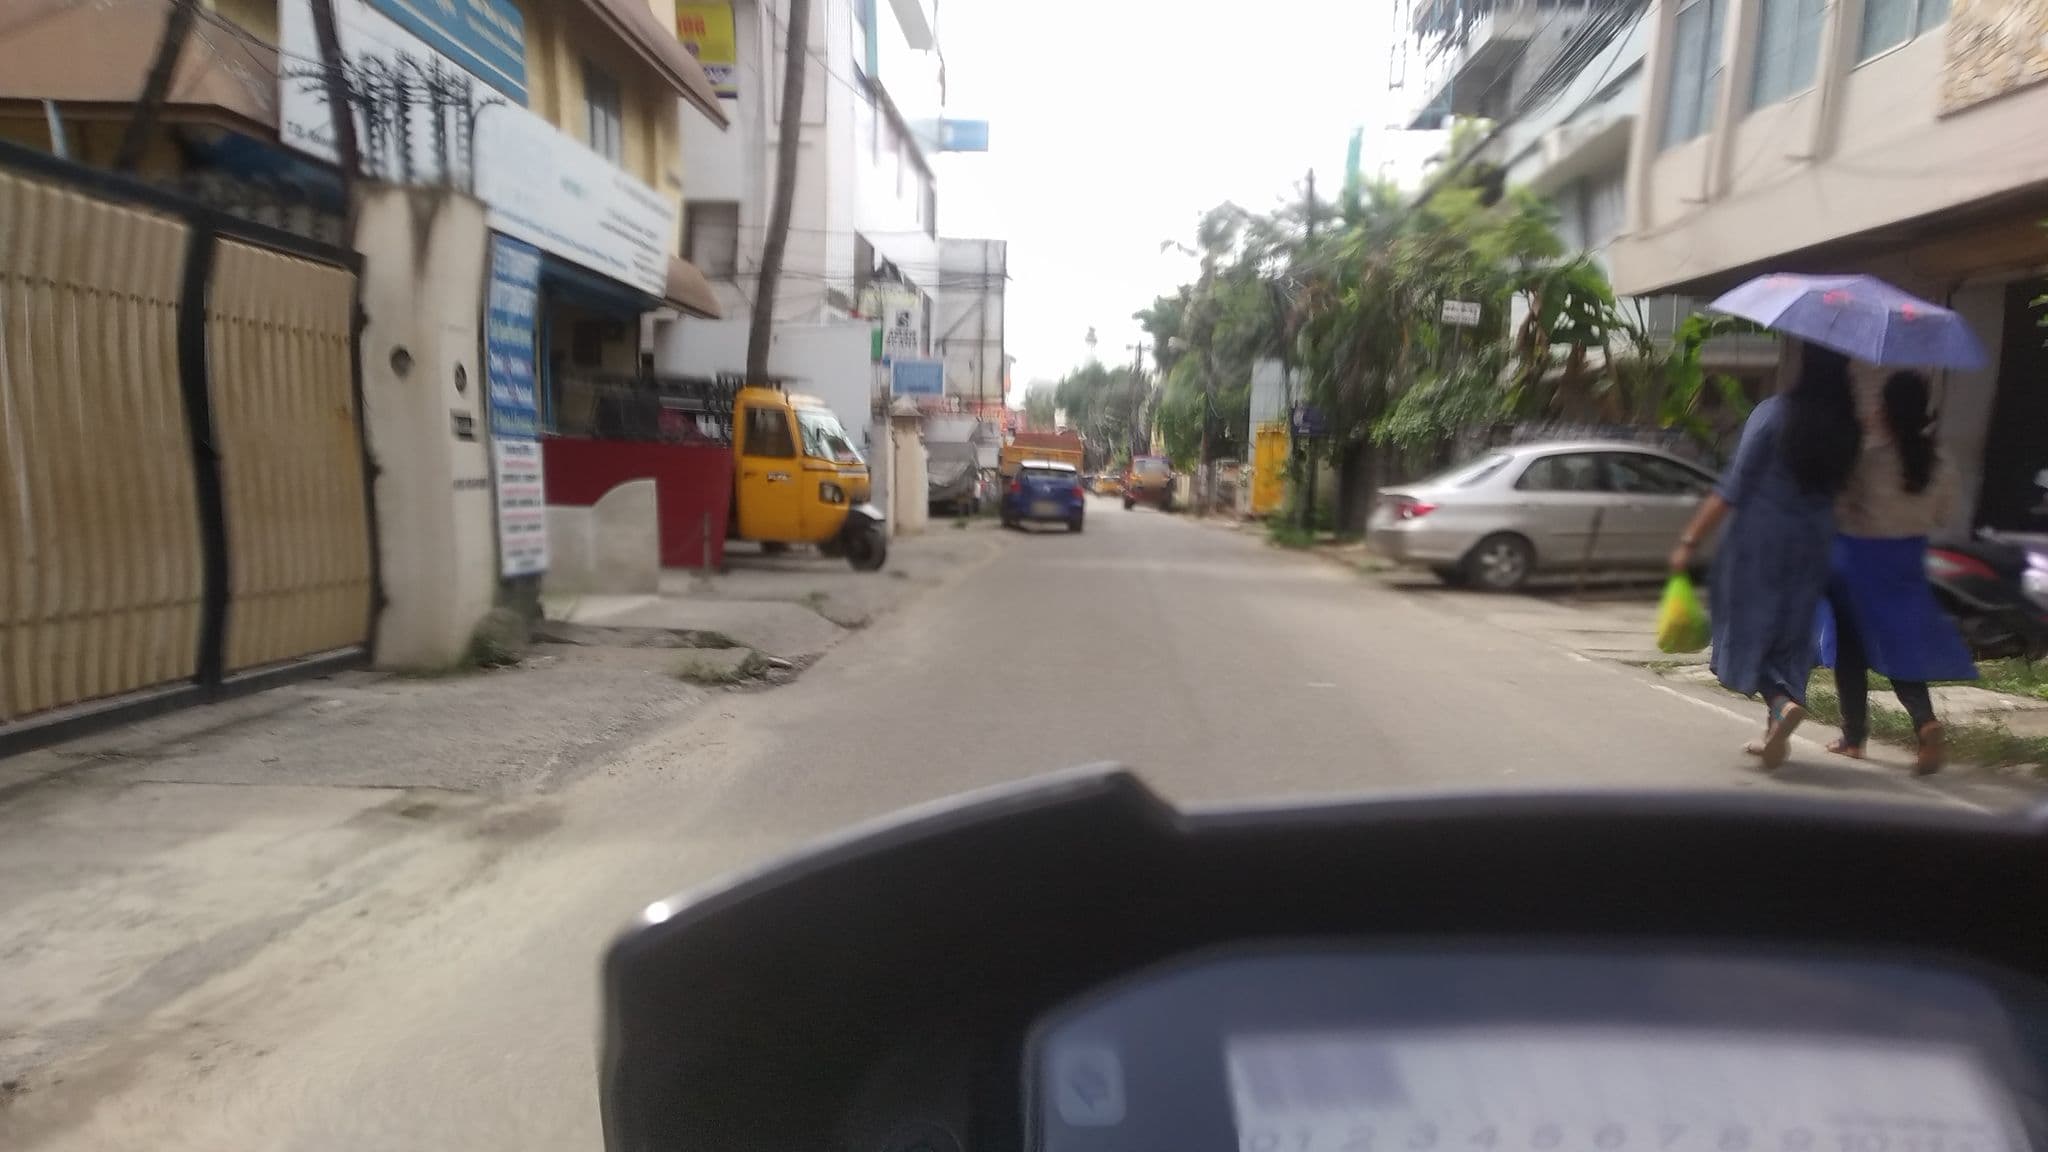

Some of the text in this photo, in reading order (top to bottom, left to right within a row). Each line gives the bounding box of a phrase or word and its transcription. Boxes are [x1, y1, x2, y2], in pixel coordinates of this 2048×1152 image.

[1407, 1121, 1439, 1150] 3
[1470, 1123, 1500, 1150] 4
[1592, 1122, 1627, 1150] 6
[1656, 1123, 1689, 1150] 7
